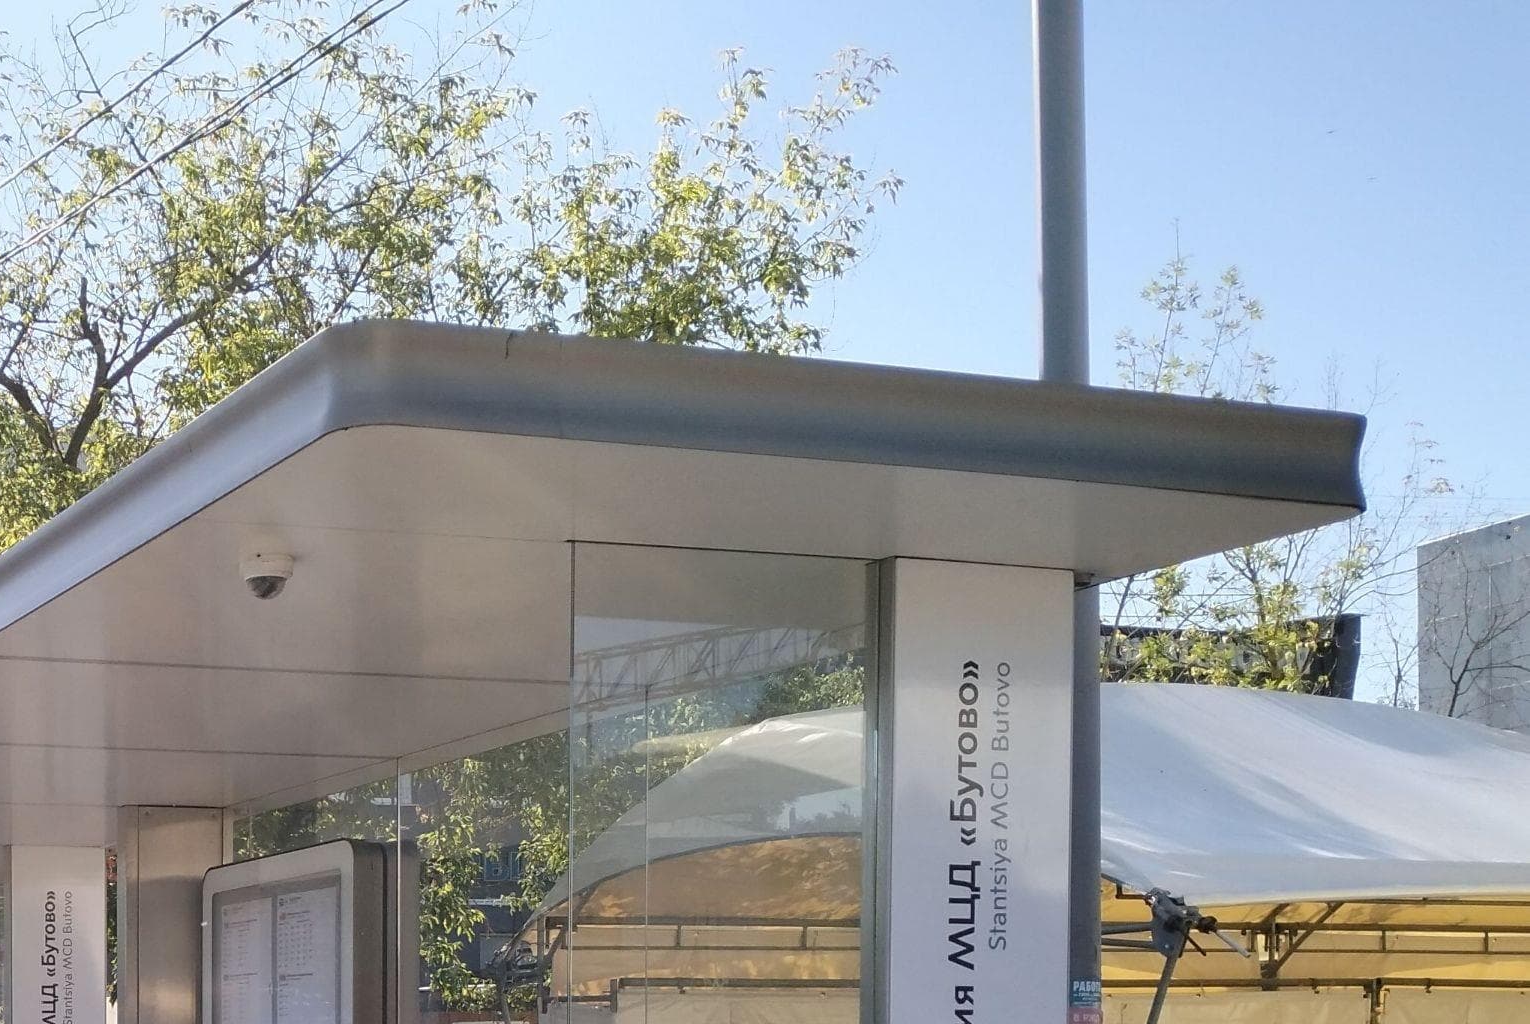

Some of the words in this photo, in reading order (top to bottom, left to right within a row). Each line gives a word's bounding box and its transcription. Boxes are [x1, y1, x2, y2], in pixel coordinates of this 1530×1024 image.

[991, 662, 1010, 751] Butovo
[949, 660, 984, 846] «Бутово»
[990, 762, 1008, 829] MCD
[41, 890, 59, 977] «Бутово»
[63, 891, 73, 935] Butovo
[948, 861, 981, 970] МЦД
[988, 838, 1011, 950] Stantsiya
[64, 939, 73, 968] MCD
